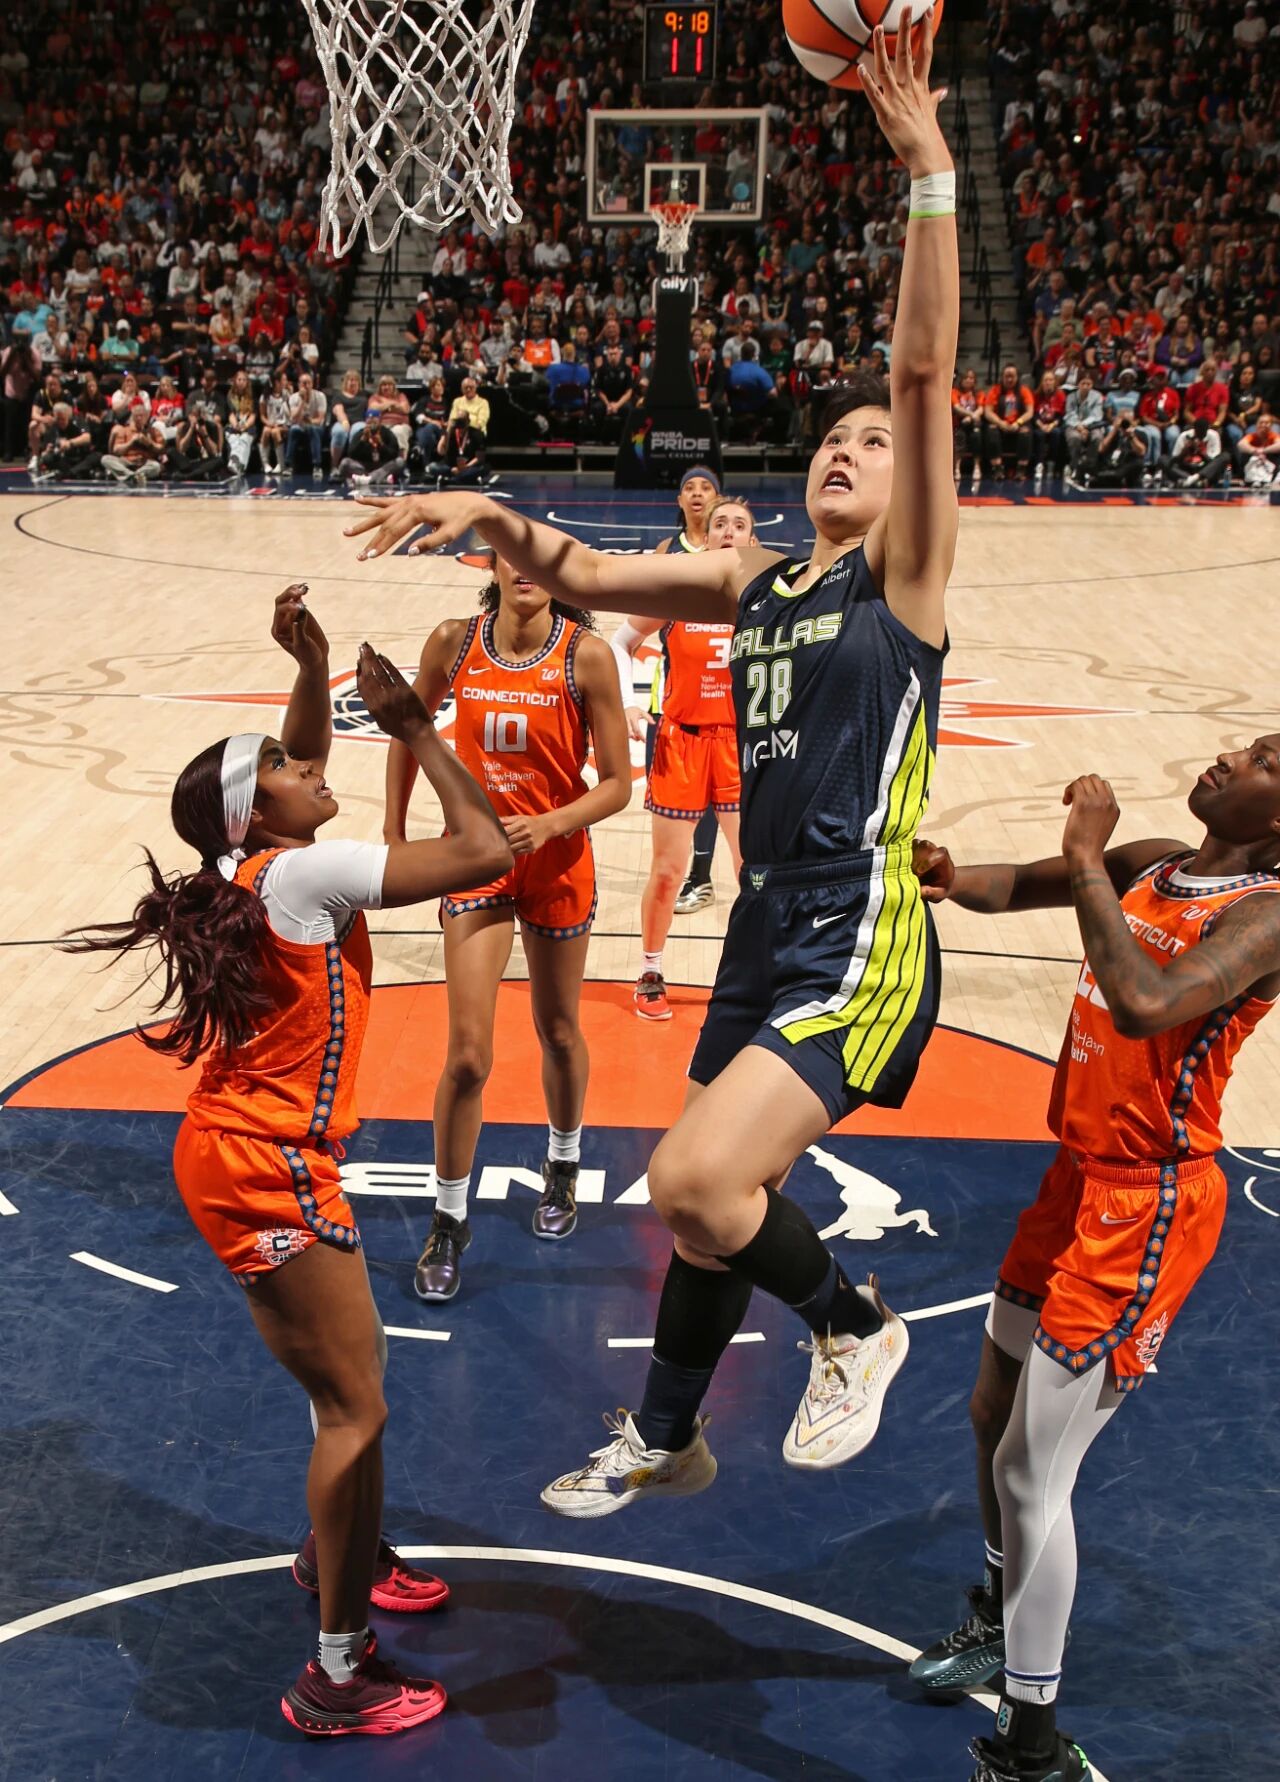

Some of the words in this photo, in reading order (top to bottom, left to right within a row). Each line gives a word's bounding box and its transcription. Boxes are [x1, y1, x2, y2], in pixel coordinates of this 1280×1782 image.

[665, 11, 709, 34] 9:18
[671, 37, 703, 73] 11
[660, 274, 689, 293] ally
[651, 438, 711, 451] PRIDE
[820, 568, 851, 588] Albert
[685, 622, 735, 633] CONNECT
[730, 612, 843, 661] DALLAS
[701, 683, 732, 691] NewHav
[701, 690, 725, 698] Health
[747, 657, 793, 728] 28
[462, 687, 560, 707] CONNECTICUT
[484, 711, 528, 752] 10
[482, 761, 501, 772] Yale
[484, 771, 535, 782] NewHaven
[487, 781, 518, 793] Health
